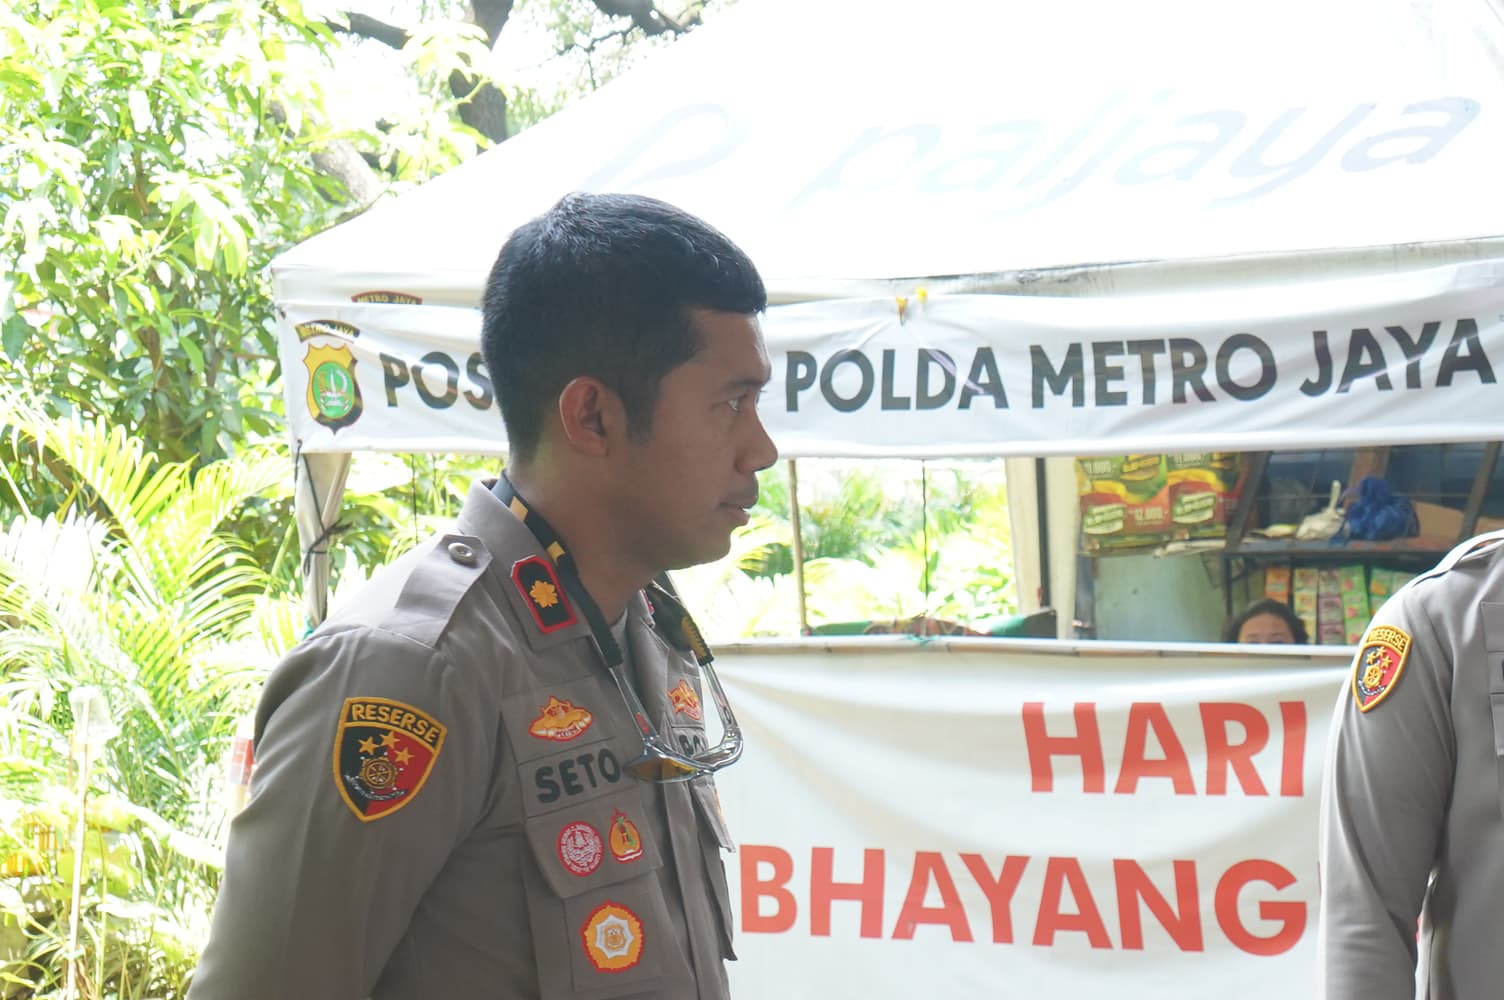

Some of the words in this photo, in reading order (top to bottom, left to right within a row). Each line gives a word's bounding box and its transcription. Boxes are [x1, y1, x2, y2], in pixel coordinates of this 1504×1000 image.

[378, 350, 496, 412] POS
[785, 348, 1010, 414] POLDA
[1029, 334, 1279, 411] METRO
[1299, 317, 1498, 400] JAYA
[351, 703, 440, 744] RESERSE
[1022, 702, 1308, 799] HARI
[535, 748, 622, 804] SETO
[740, 845, 1322, 957] BHAYANG
